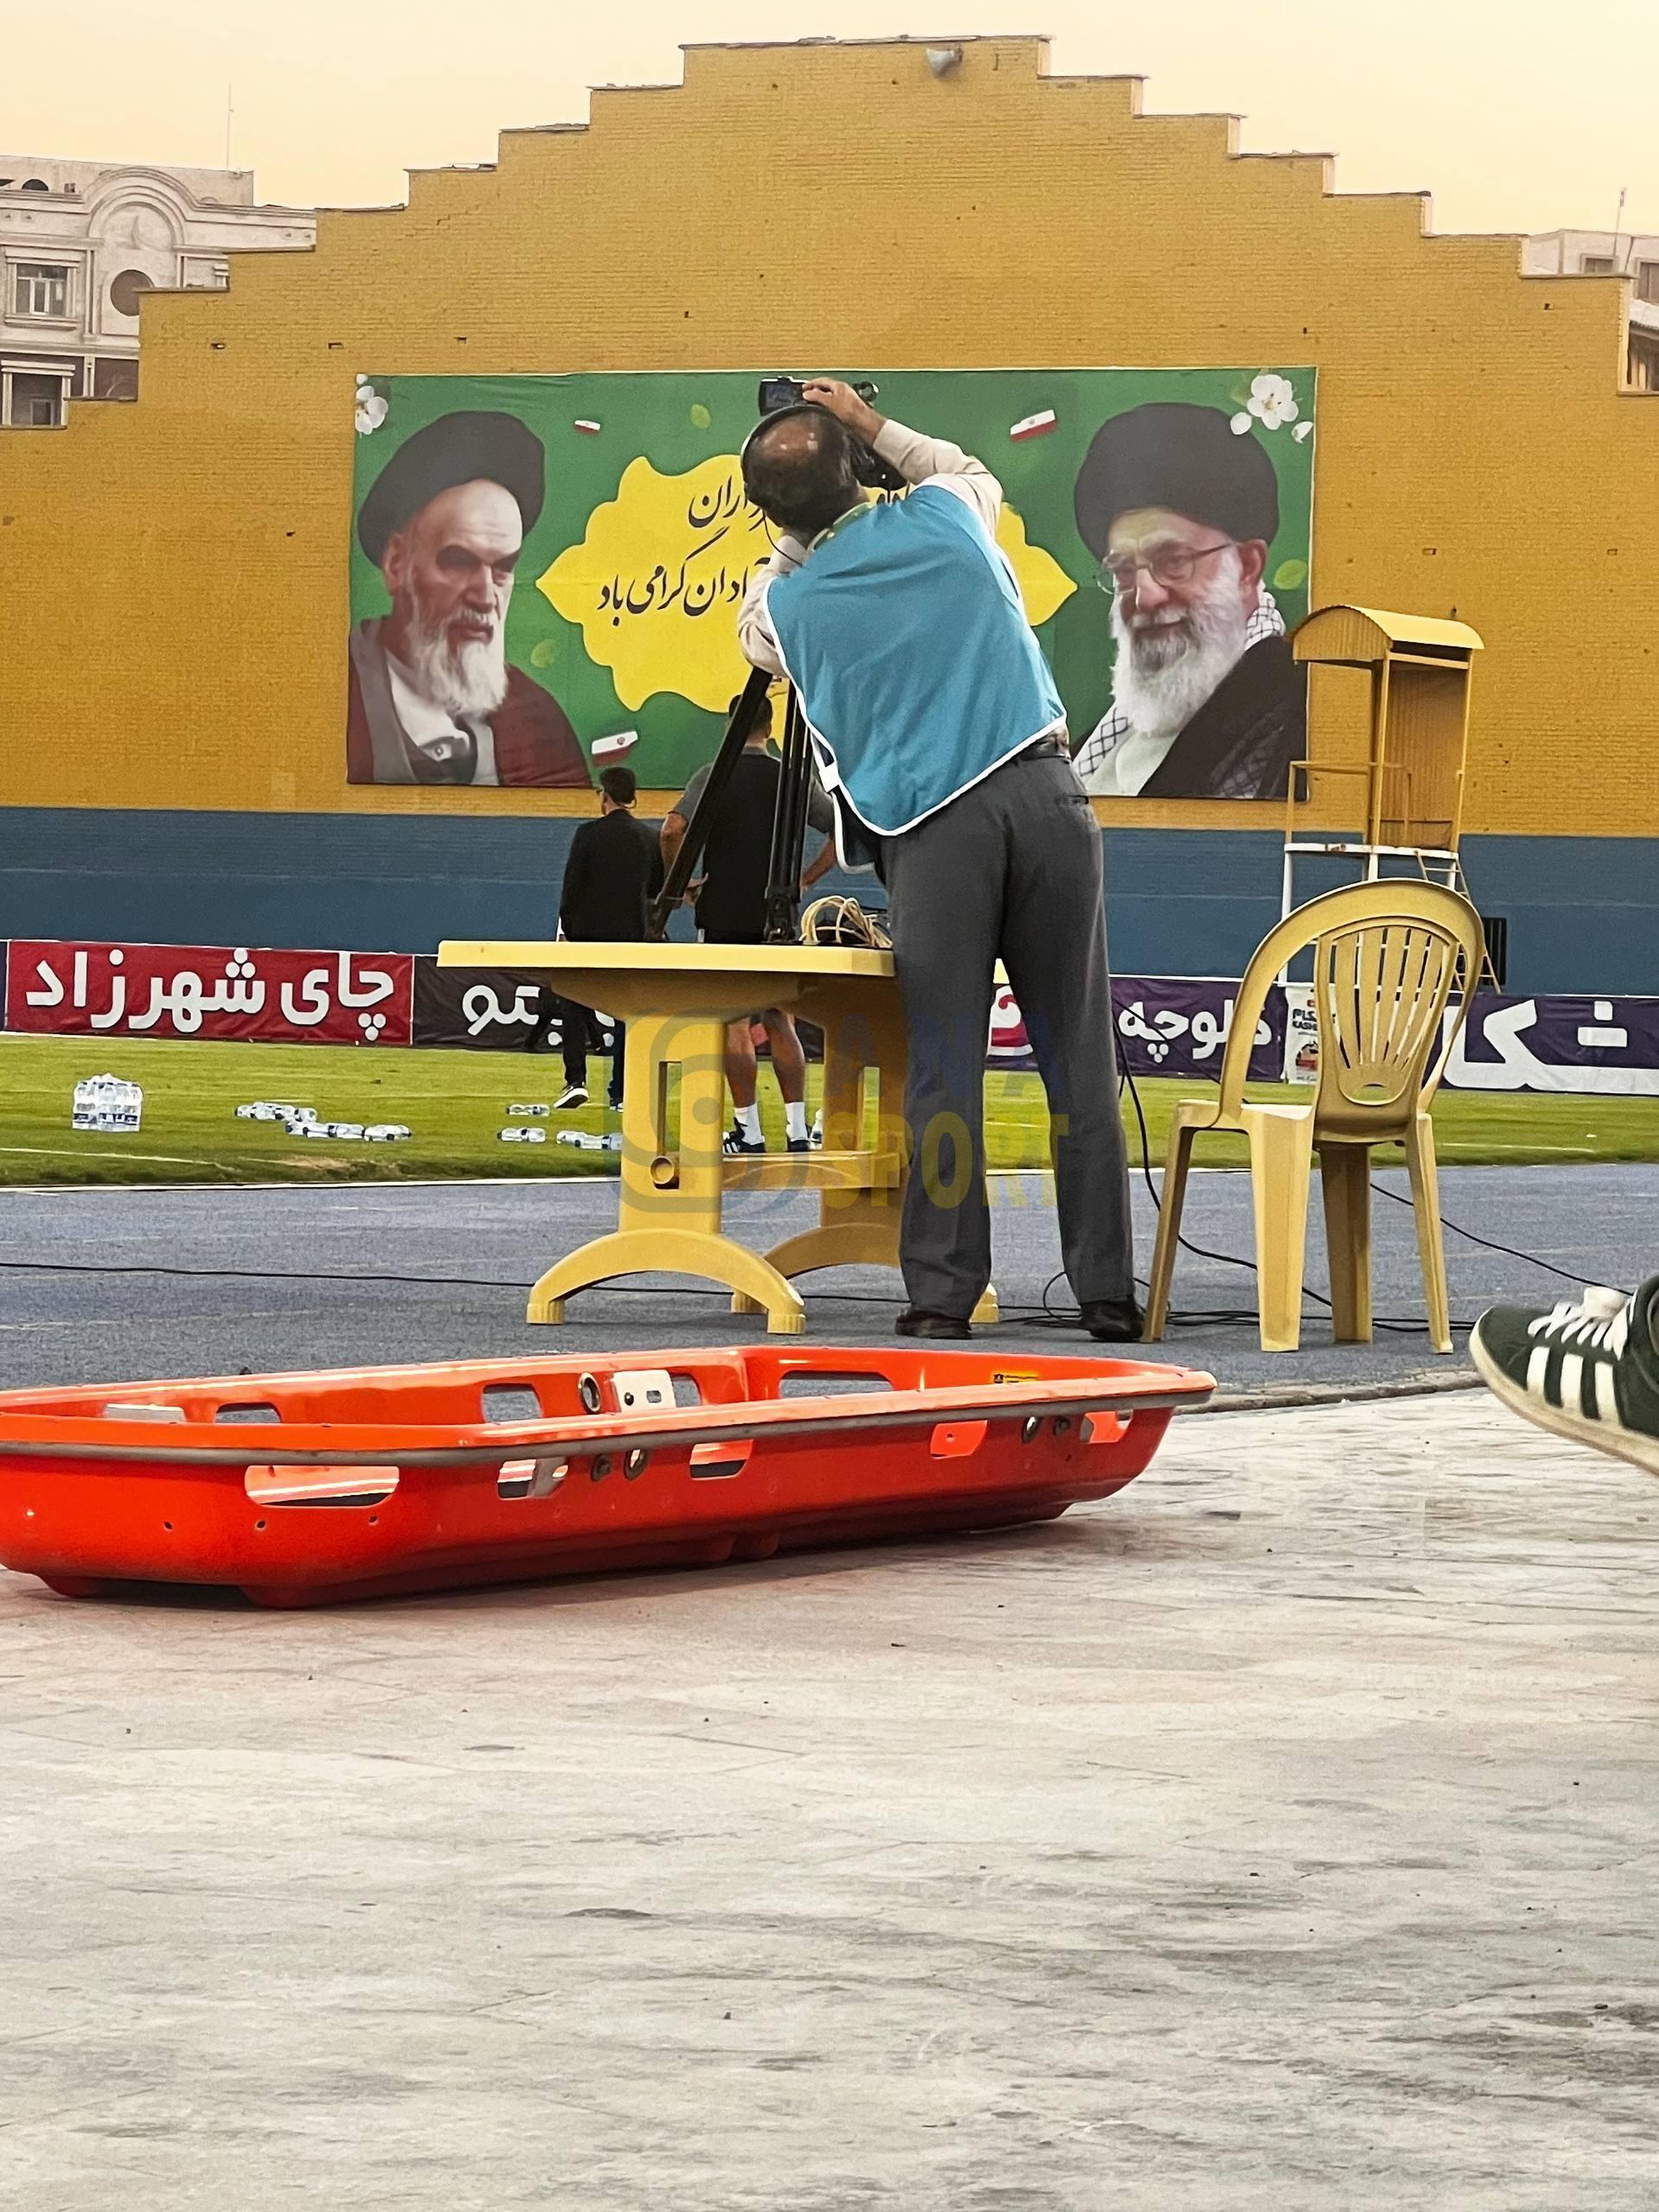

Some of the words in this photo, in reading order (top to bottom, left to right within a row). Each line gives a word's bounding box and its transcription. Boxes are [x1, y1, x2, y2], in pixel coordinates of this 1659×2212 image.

[596, 574, 624, 626] باد
[626, 525, 730, 614] گرامی
[25, 948, 266, 1033] شهرزاد
[281, 951, 395, 1042] چای
